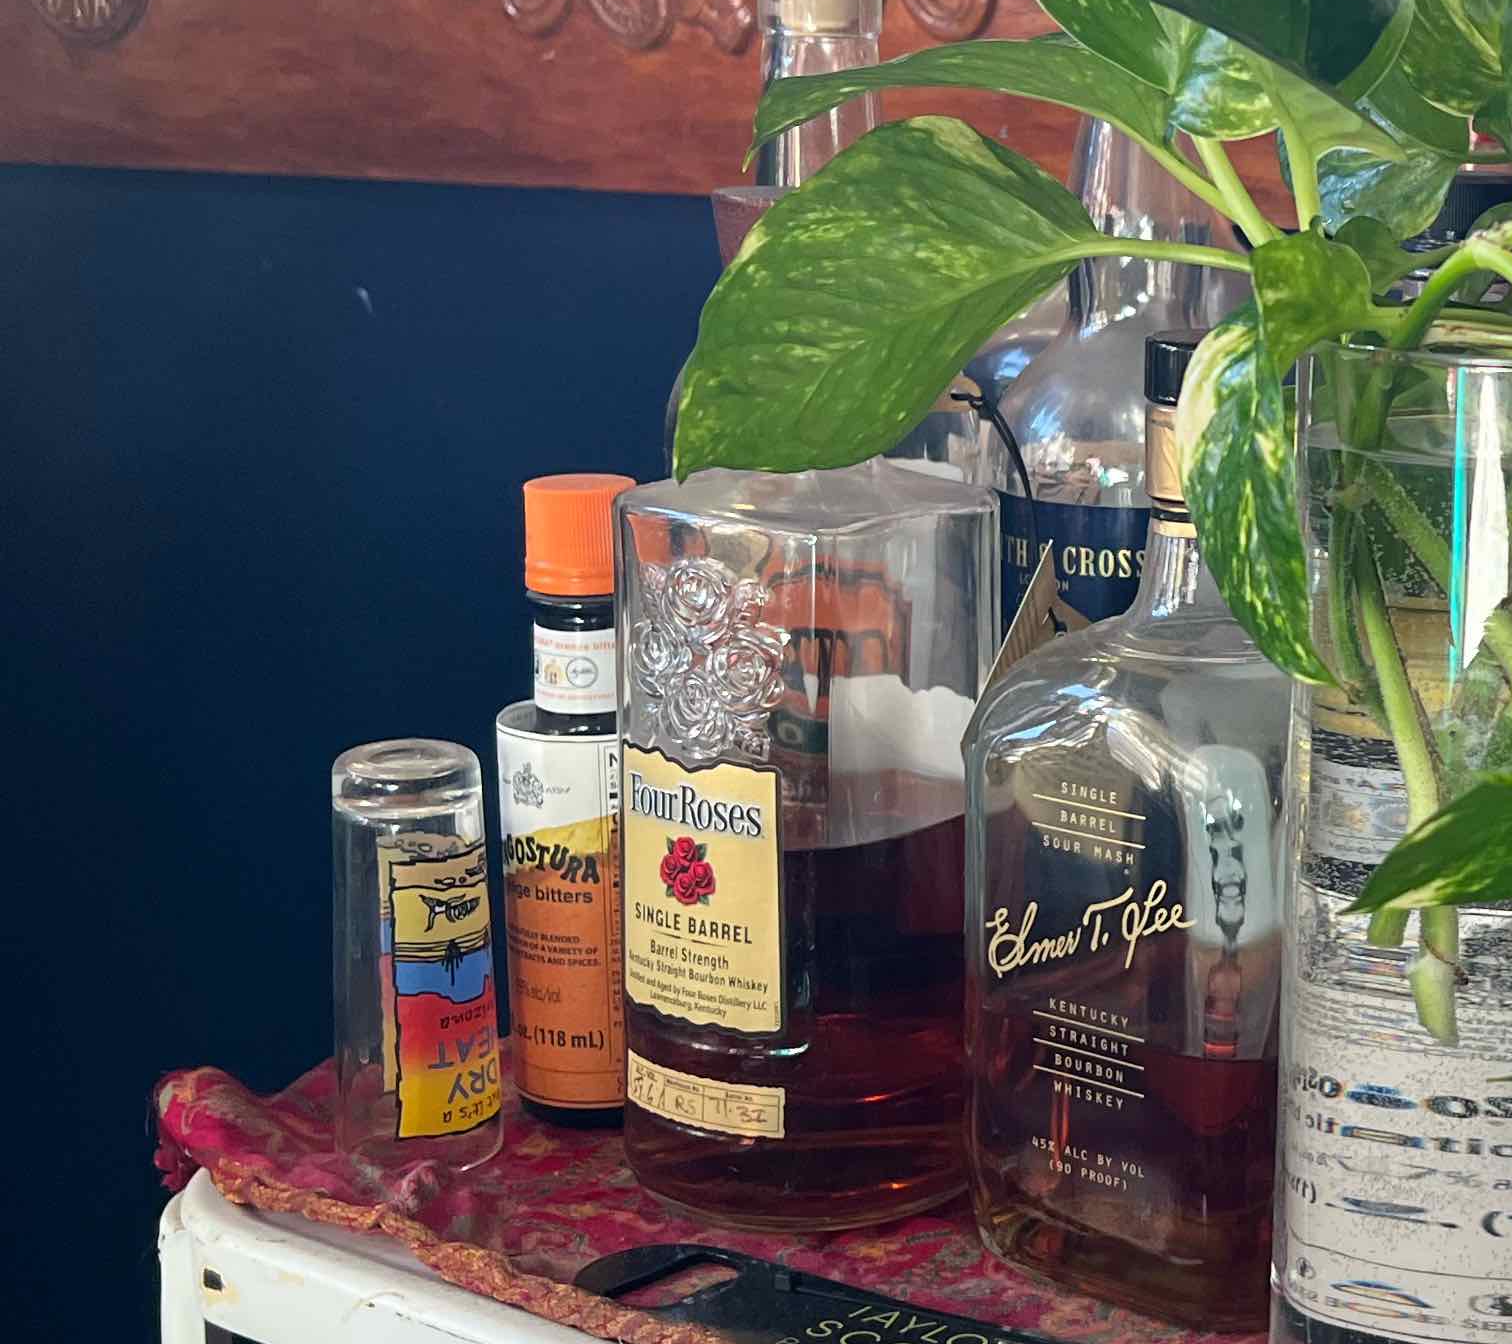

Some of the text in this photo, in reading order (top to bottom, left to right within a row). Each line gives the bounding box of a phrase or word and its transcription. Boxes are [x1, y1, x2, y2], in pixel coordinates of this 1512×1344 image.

[630, 772, 762, 838] Four Roses
[1060, 781, 1117, 805] SINGLE
[1060, 810, 1116, 833] BARREL
[1042, 834, 1134, 865] SOUR MASH
[535, 885, 593, 904] bitters
[635, 902, 753, 944] SINGLE BARREL
[650, 939, 729, 970] Barrel Strength
[985, 901, 1081, 978] Elmer
[656, 959, 687, 978] Straight
[688, 968, 726, 986] Bourbon
[728, 976, 768, 994] Whiskey
[1049, 998, 1129, 1029] KENTUCKY
[571, 1031, 604, 1051] mL)
[1050, 1025, 1128, 1056] STRAIGHT
[1054, 1053, 1124, 1083] BOURBON
[1053, 1080, 1123, 1110] WHISKEY
[1064, 1145, 1088, 1161] ALC
[1097, 1153, 1112, 1167] BY
[1122, 1161, 1145, 1178] VOL
[1081, 1168, 1127, 1190] PROOF)
